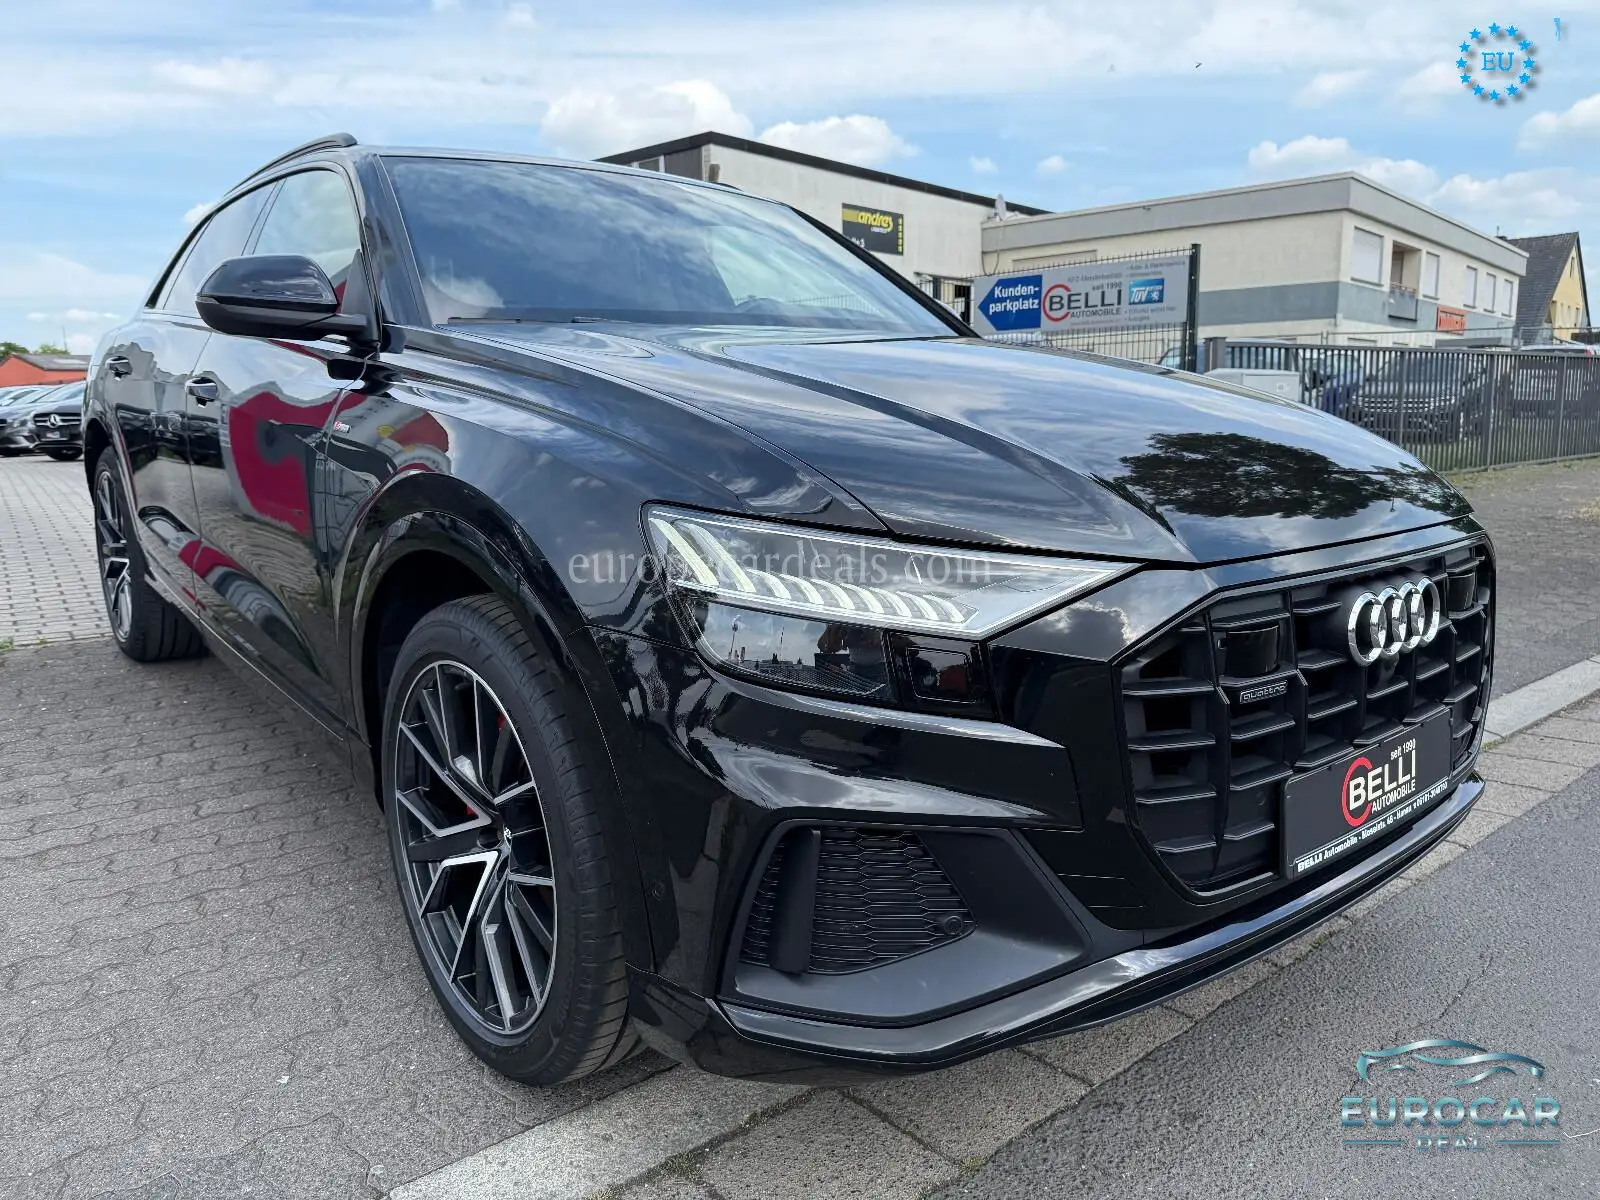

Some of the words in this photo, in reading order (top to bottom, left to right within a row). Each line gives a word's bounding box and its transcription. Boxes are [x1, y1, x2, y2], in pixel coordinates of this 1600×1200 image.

[994, 284, 1040, 298] Kunden-
[989, 298, 1039, 315] parkplatz
[1049, 289, 1122, 311] BELLI
[1070, 307, 1121, 318] AUTOMOBILE
[1243, 685, 1286, 702] quattro
[1390, 745, 1402, 760] seit
[1349, 750, 1416, 811] BELLI
[1371, 779, 1416, 814] AUTOMOBILE
[1297, 852, 1323, 873] BELLI
